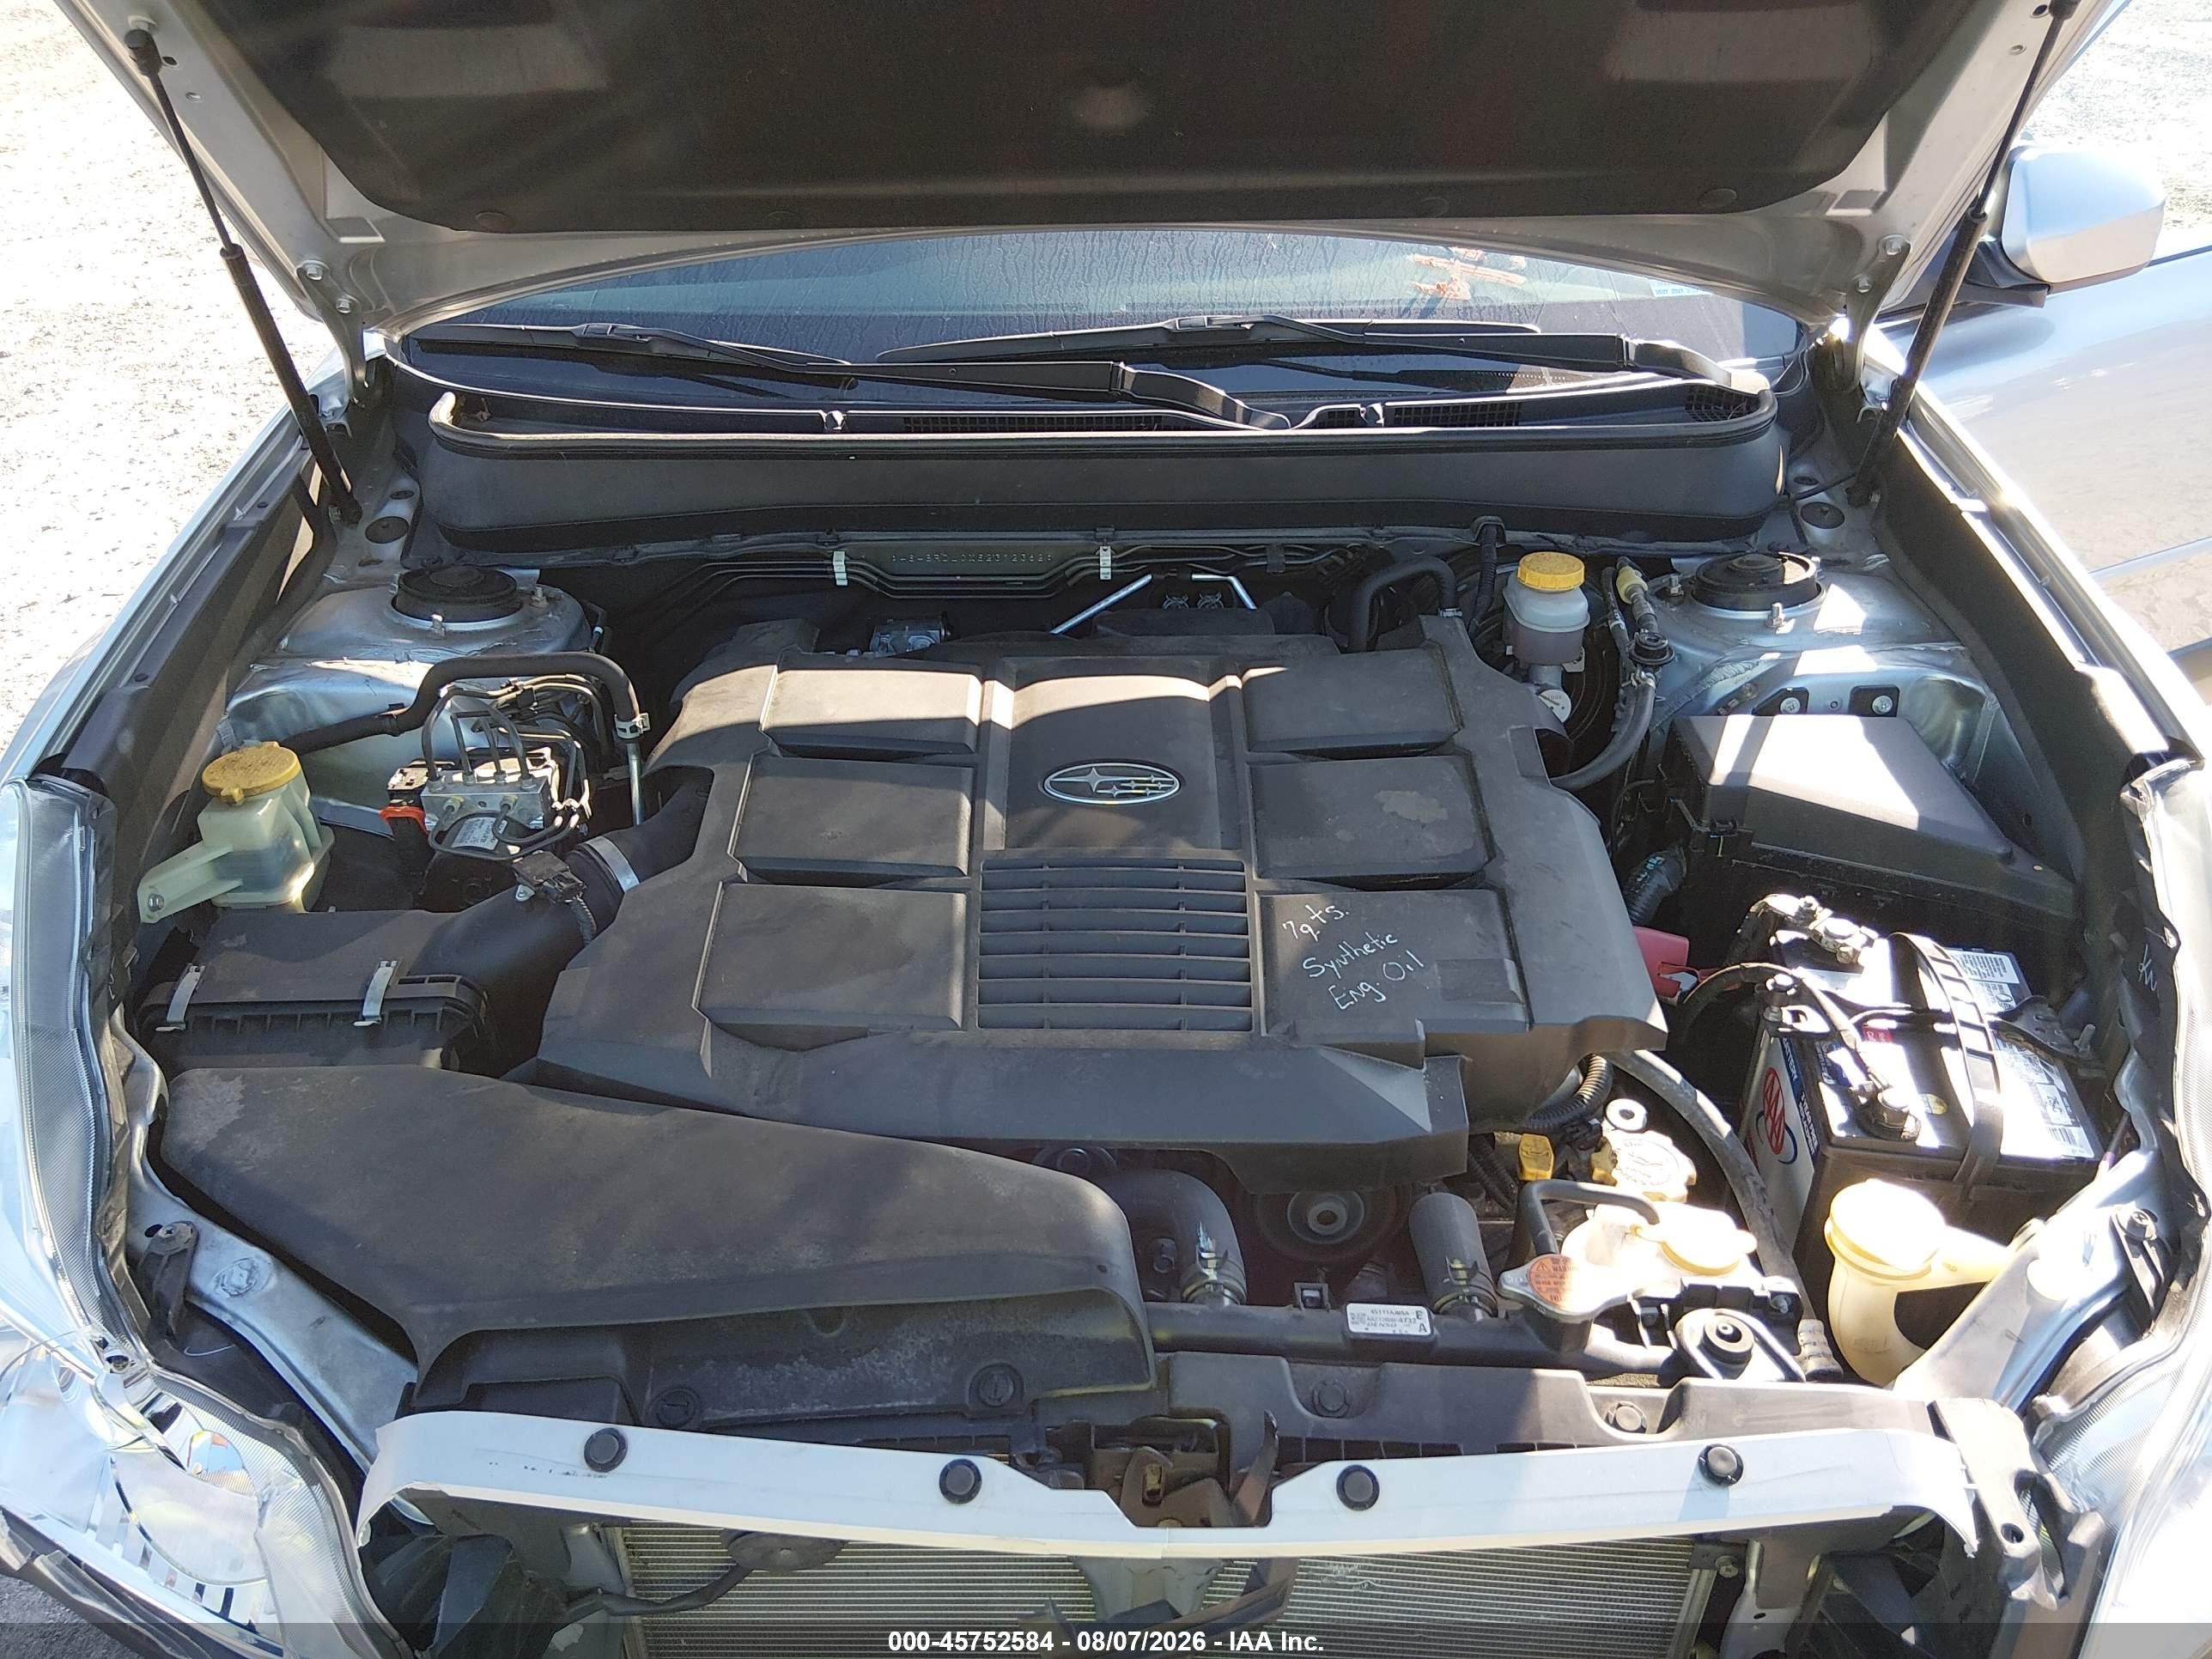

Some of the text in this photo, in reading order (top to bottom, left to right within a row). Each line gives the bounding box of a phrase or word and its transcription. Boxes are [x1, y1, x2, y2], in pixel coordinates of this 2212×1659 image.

[1303, 931, 1398, 980] Synthetic
[1382, 949, 1424, 981] Oil
[1802, 1098, 1814, 1125] YEAR
[1807, 1123, 1820, 1152] FREE
[1418, 1322, 1428, 1333] A
